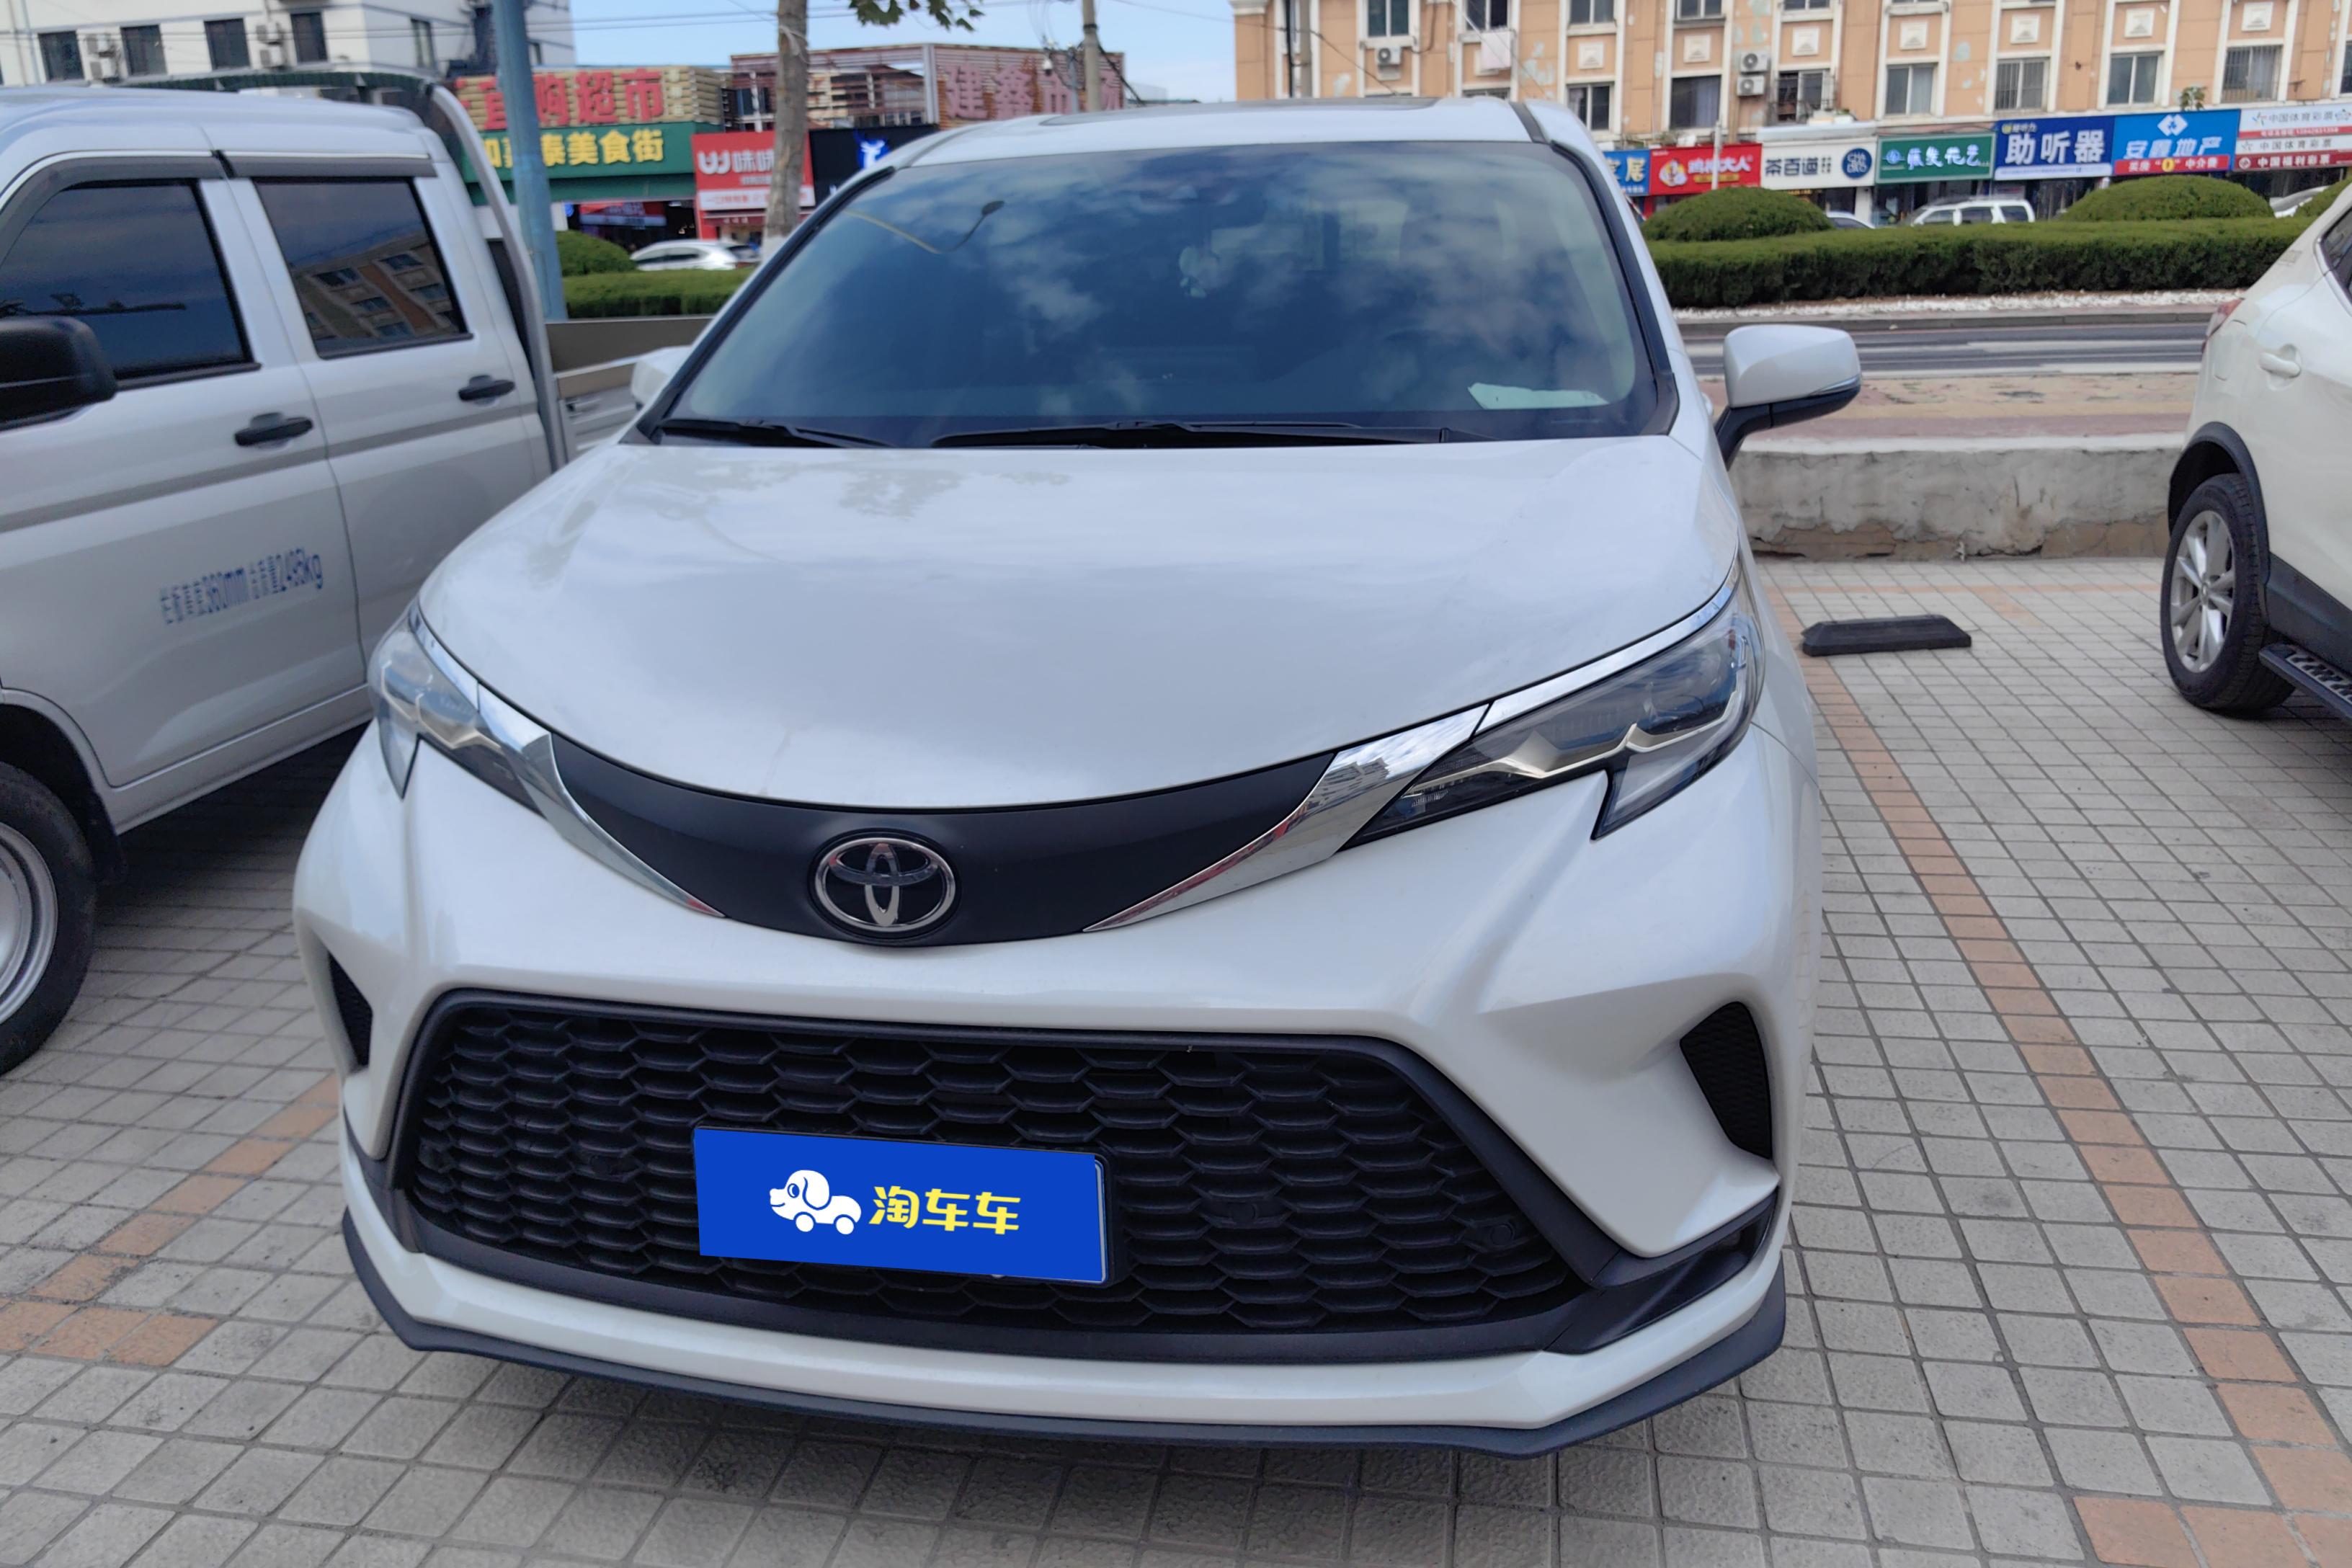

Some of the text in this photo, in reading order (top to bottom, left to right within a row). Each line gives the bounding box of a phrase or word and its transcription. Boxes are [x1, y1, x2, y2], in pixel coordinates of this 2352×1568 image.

[2005, 130, 2104, 164] 助听器
[2259, 138, 2331, 151] 中国体育彩票
[1765, 158, 1818, 177] 茶百道
[2258, 154, 2330, 168] 中国福利彩票
